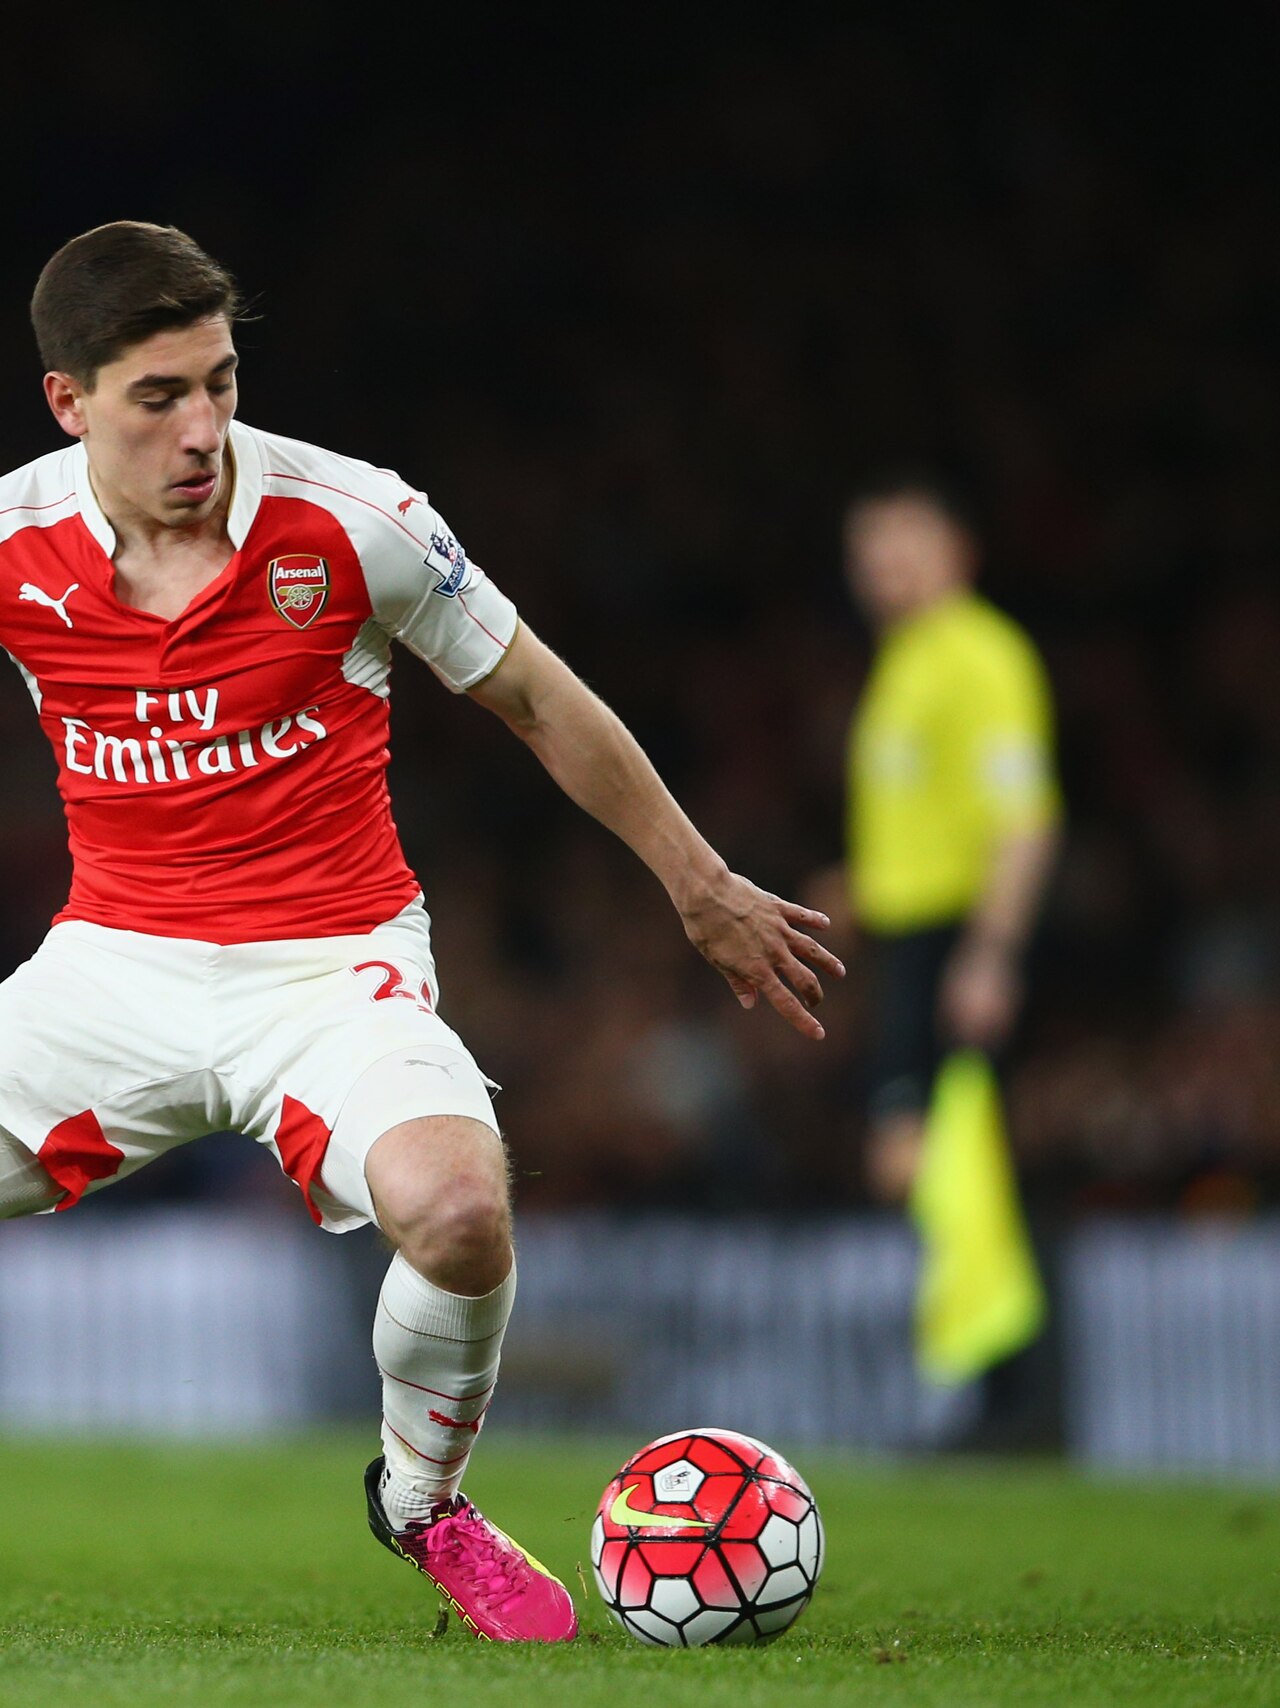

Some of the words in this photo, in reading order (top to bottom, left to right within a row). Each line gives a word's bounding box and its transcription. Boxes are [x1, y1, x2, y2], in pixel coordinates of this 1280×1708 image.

[276, 565, 322, 579] Arsenal
[135, 687, 219, 731] Fly
[61, 704, 327, 784] Emirates
